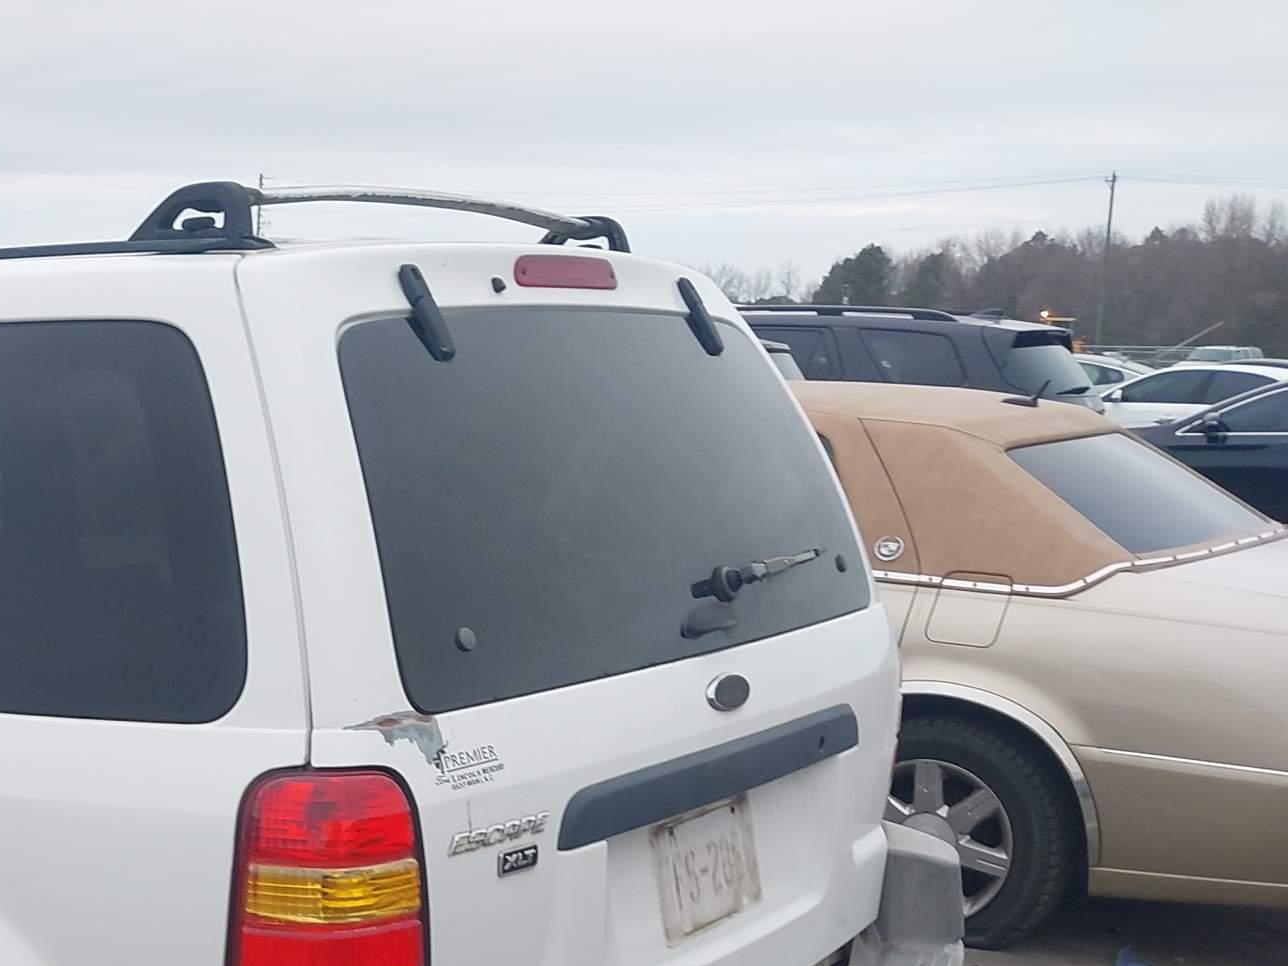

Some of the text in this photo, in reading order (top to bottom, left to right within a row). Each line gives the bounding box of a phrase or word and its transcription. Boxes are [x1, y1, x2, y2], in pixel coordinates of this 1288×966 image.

[443, 745, 498, 768] PREMIER
[447, 811, 550, 857] ESCAPE
[503, 848, 536, 871] XLT
